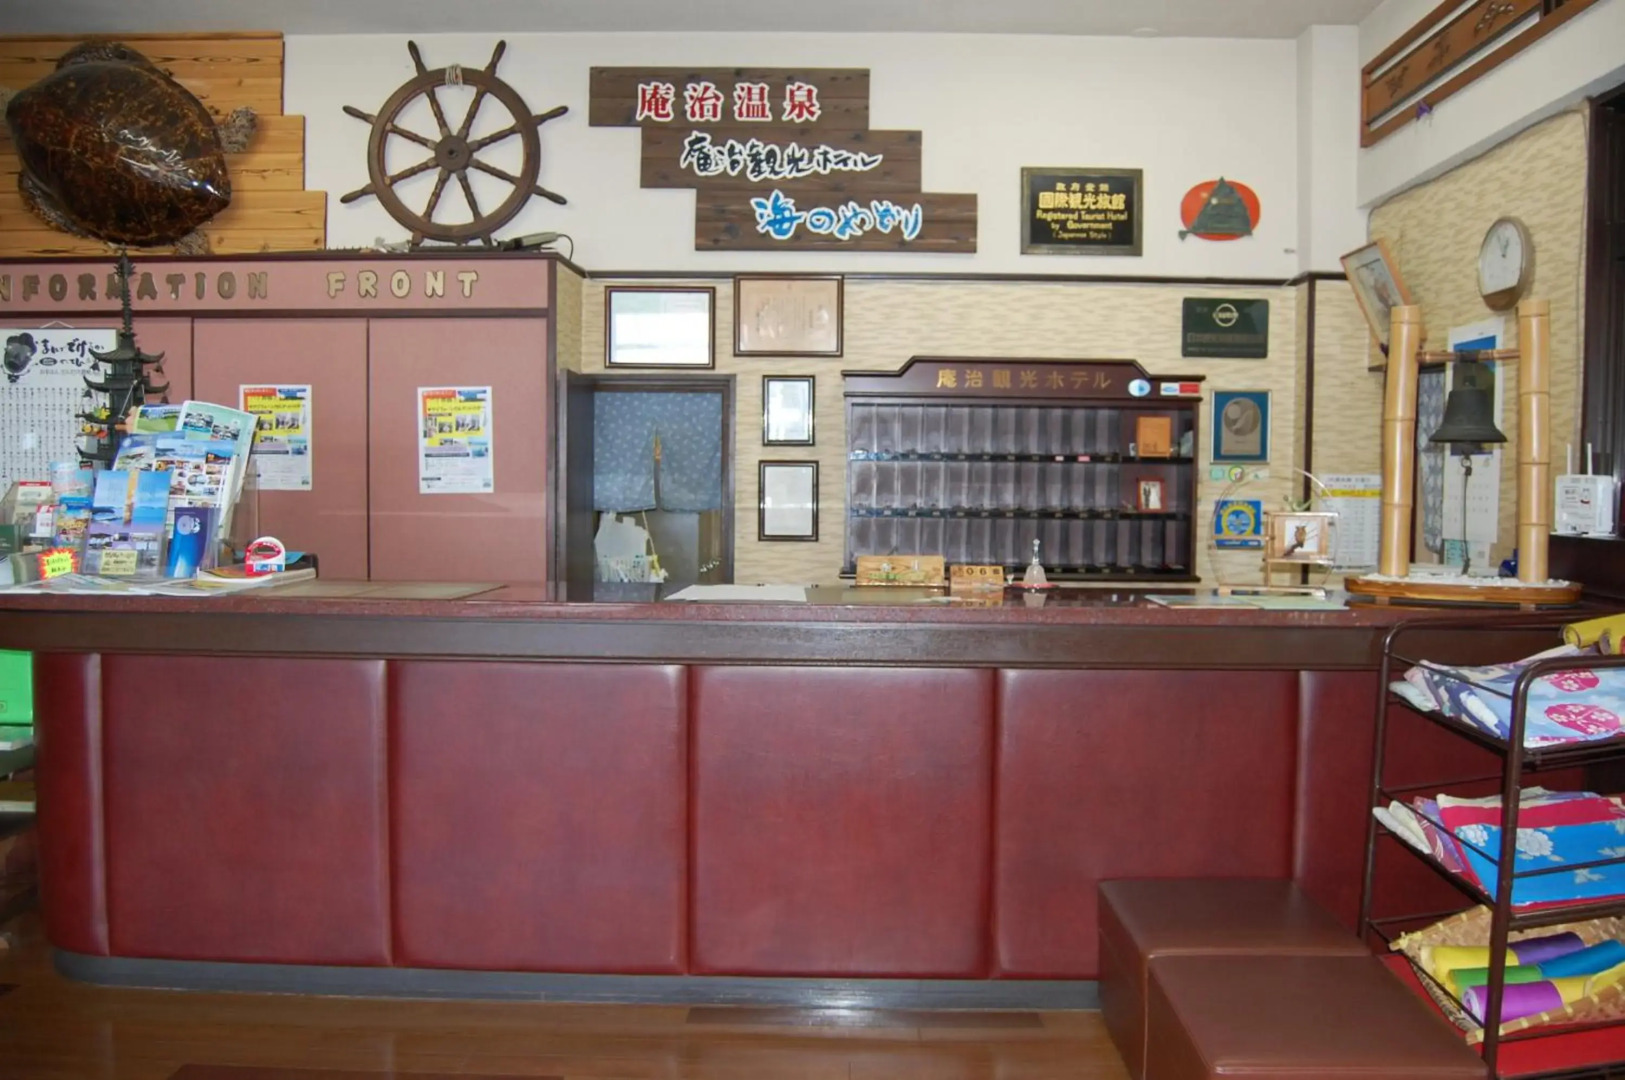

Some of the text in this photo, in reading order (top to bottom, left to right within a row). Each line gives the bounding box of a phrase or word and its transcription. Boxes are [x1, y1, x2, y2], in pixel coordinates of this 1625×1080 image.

[635, 82, 822, 122] 庵治温泉
[680, 130, 884, 182] 庵治観光ホテル
[1036, 209, 1128, 222] Registered Tourist Hotel
[1051, 220, 1113, 231] by Government
[326, 269, 479, 299] FRONT
[936, 368, 1112, 390] 庵治観光ホテル
